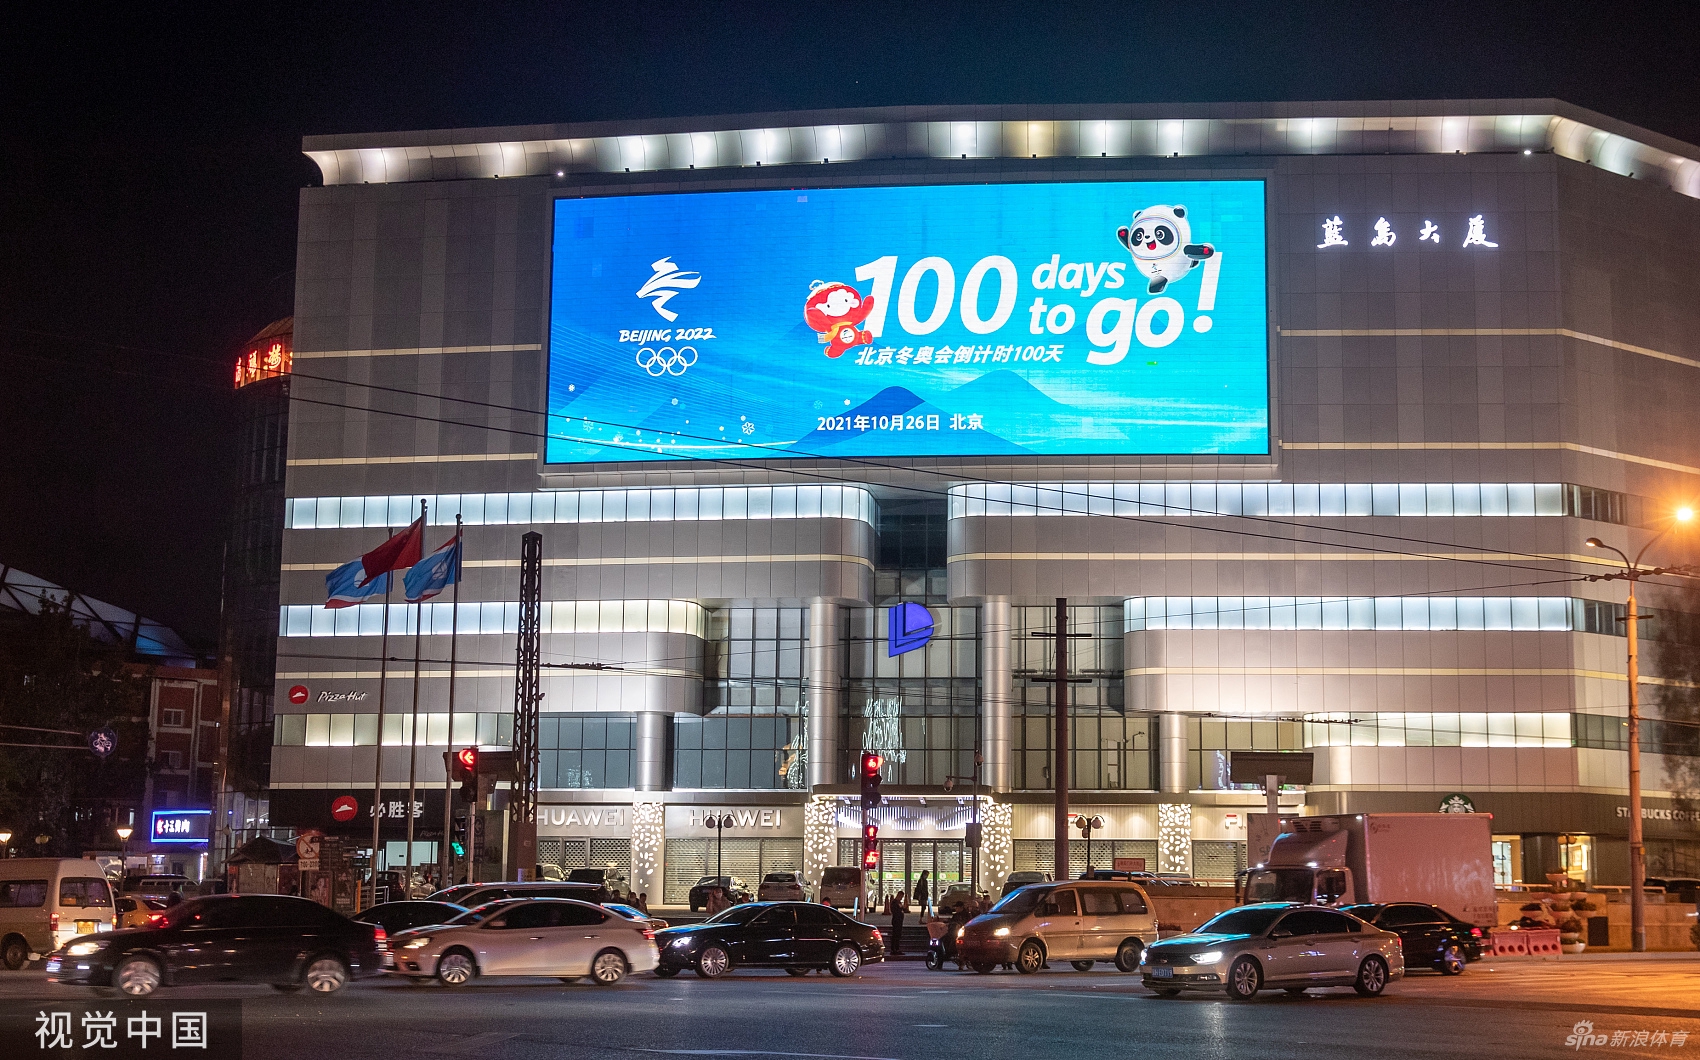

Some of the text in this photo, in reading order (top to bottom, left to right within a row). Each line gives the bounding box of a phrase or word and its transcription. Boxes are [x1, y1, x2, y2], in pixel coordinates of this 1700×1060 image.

[854, 253, 1127, 339] 100 days
[1028, 297, 1077, 336] to
[618, 327, 718, 346] BEIJING 2022
[854, 343, 1065, 367] 北京冬奥会倒计时100天
[816, 413, 984, 433] 2021年10月26日 北京
[317, 690, 369, 703] Pizza Hut
[369, 799, 424, 819] 必胜客
[1616, 806, 1672, 820] STBUCKS
